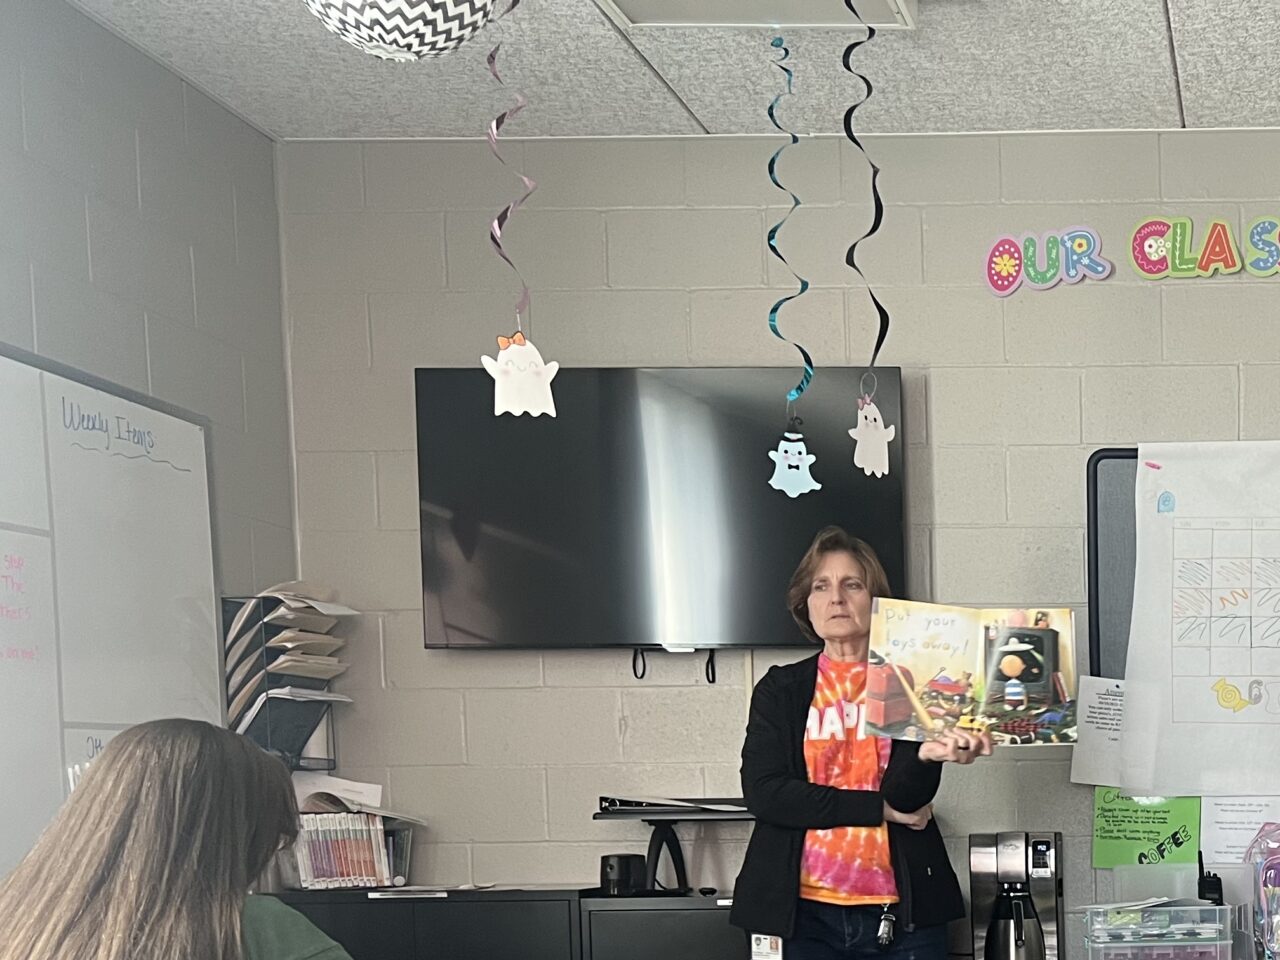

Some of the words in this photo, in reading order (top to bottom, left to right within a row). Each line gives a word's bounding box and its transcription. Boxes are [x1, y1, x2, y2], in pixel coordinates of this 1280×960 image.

[986, 226, 1113, 295] OUR
[61, 395, 110, 451] Weekly
[115, 415, 155, 454] Items
[885, 608, 911, 624] Put
[925, 616, 957, 631] your
[922, 638, 969, 658] away!
[1138, 825, 1192, 864] COFFEE
